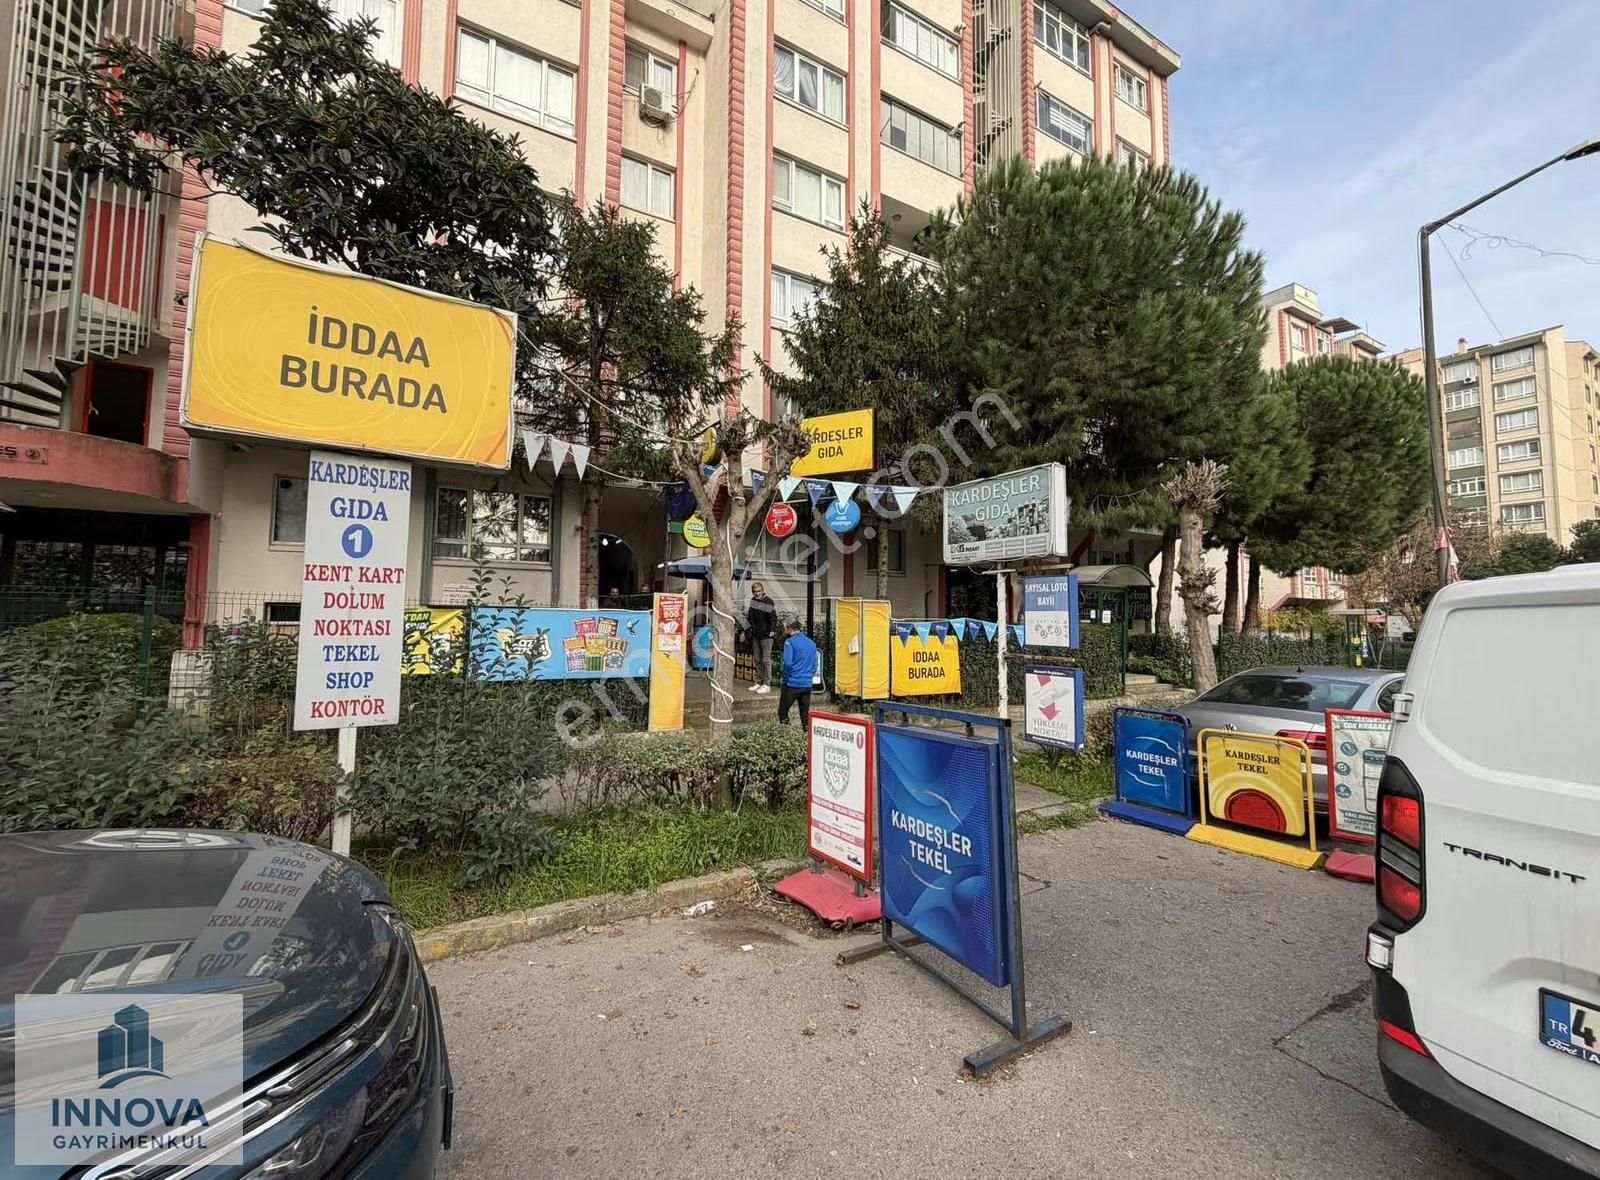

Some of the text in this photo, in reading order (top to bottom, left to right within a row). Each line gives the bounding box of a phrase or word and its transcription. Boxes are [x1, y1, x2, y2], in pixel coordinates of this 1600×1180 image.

[307, 305, 430, 368] İDDAA
[279, 354, 448, 414] BURADA
[817, 446, 843, 459] GIDA
[951, 474, 1041, 507] KARDEŞLER
[329, 496, 389, 522] GIDA
[975, 501, 1012, 522] GIDA
[347, 529, 363, 553] 1
[303, 564, 405, 584] KENT KART
[1025, 582, 1068, 592] SAYISAL LOTO
[323, 592, 386, 610] DOLUM
[313, 619, 392, 636] NOKTASI
[322, 644, 380, 662] TEKEL
[912, 650, 941, 663] İDDAA
[326, 671, 374, 689] SHOP
[908, 666, 946, 680] BURADA
[310, 694, 385, 718] KONTÖR
[1126, 749, 1178, 767] KARDEŞLER
[1225, 749, 1281, 766] KARDEŞLER
[1138, 763, 1166, 778] TEKEL
[1236, 761, 1269, 775] TEKEL
[891, 808, 972, 858] KARDEŞLER
[908, 840, 953, 875] TEKEL
[1443, 842, 1587, 884] TRANSIT
[1549, 1018, 1569, 1035] TR
[1546, 1037, 1578, 1056] Ford
